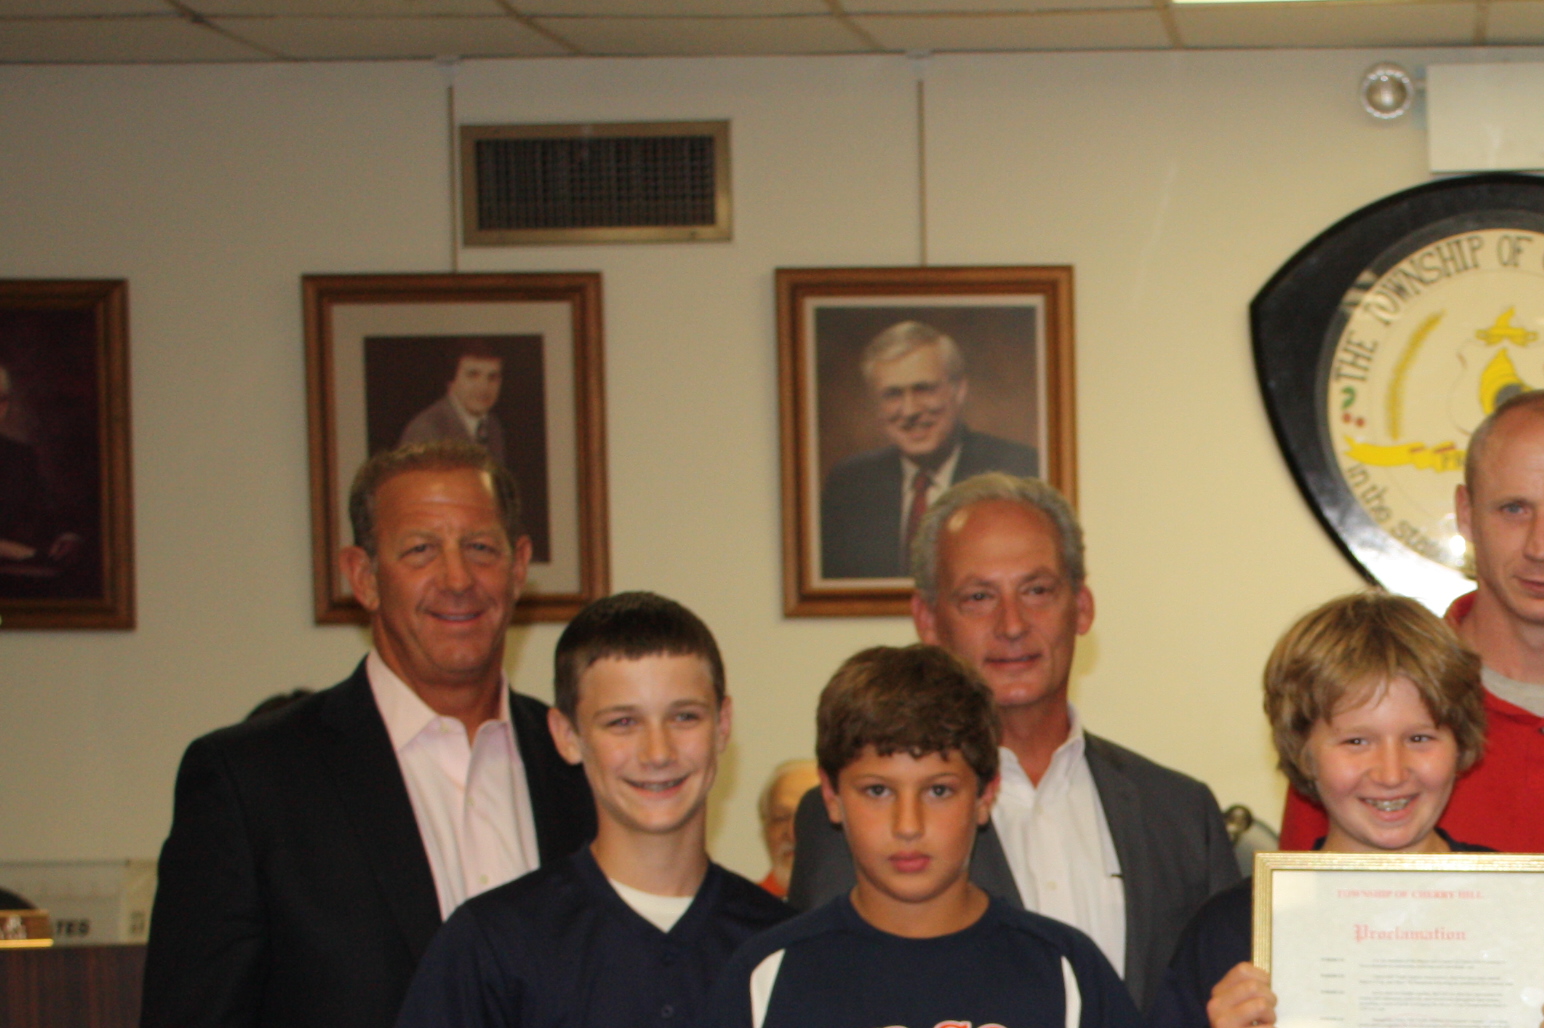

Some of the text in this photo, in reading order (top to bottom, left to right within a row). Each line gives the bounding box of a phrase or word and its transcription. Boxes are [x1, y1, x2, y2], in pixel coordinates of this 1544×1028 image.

[1334, 330, 1379, 382] THE
[1363, 234, 1484, 326] TOWNSHIP
[1497, 234, 1534, 267] OF
[1353, 923, 1467, 943] Proclamation
